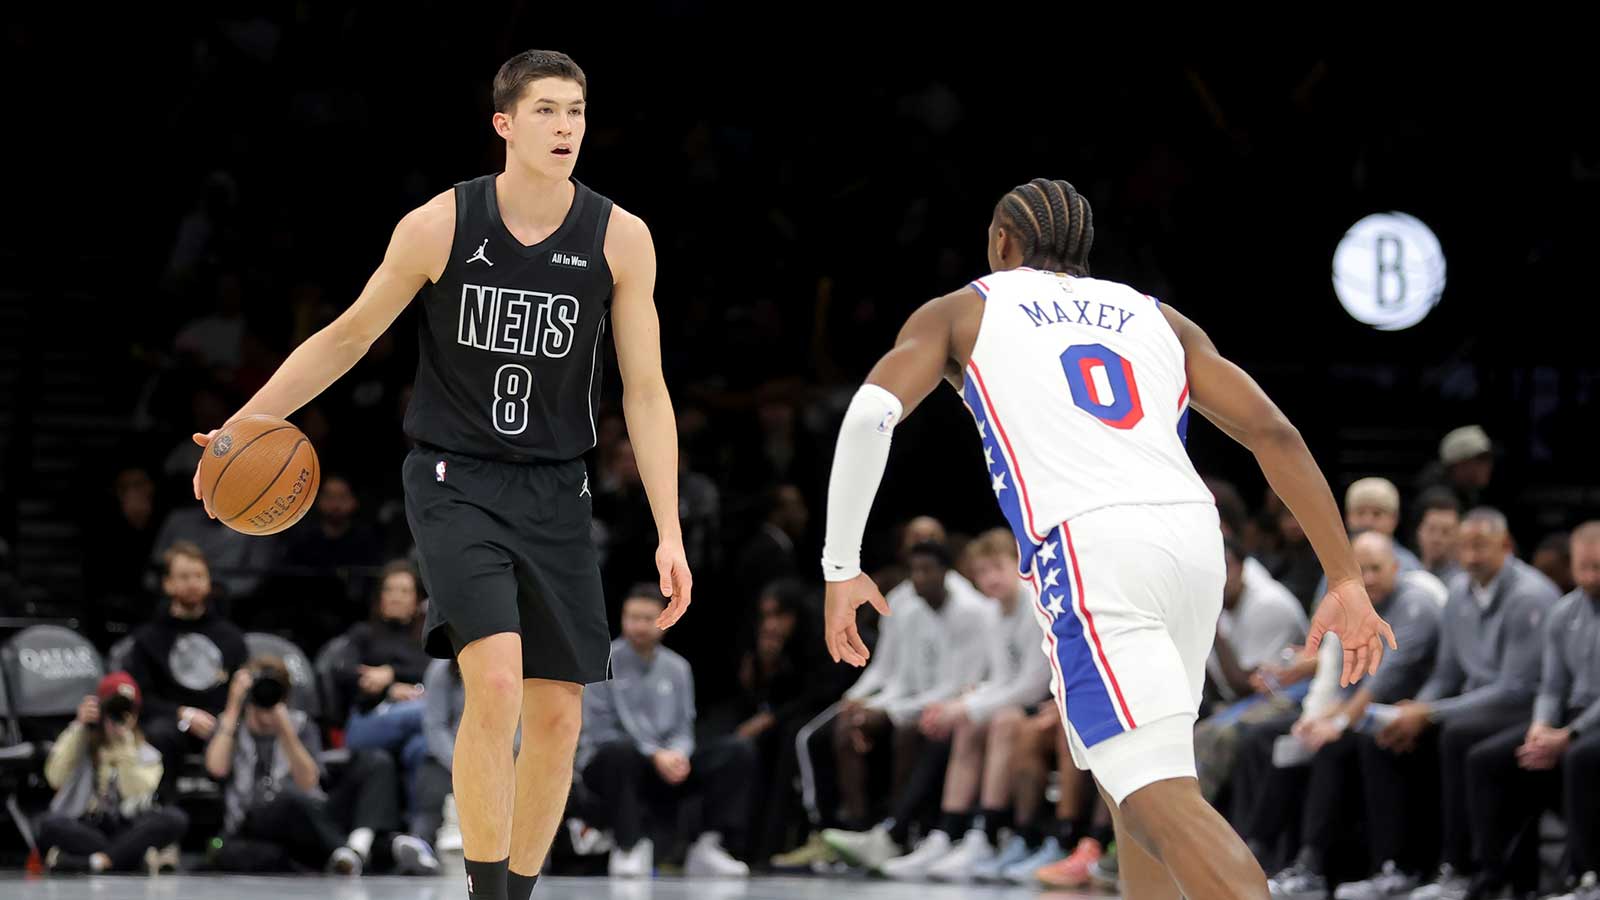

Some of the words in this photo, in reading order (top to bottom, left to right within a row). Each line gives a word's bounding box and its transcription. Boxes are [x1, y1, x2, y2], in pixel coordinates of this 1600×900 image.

[552, 253, 562, 264] All
[563, 254, 571, 265] In
[571, 255, 587, 267] Won
[1377, 232, 1406, 310] B
[457, 283, 580, 358] NETS
[1018, 300, 1135, 333] MAXEY
[492, 363, 533, 435] 8
[1059, 343, 1145, 430] 0
